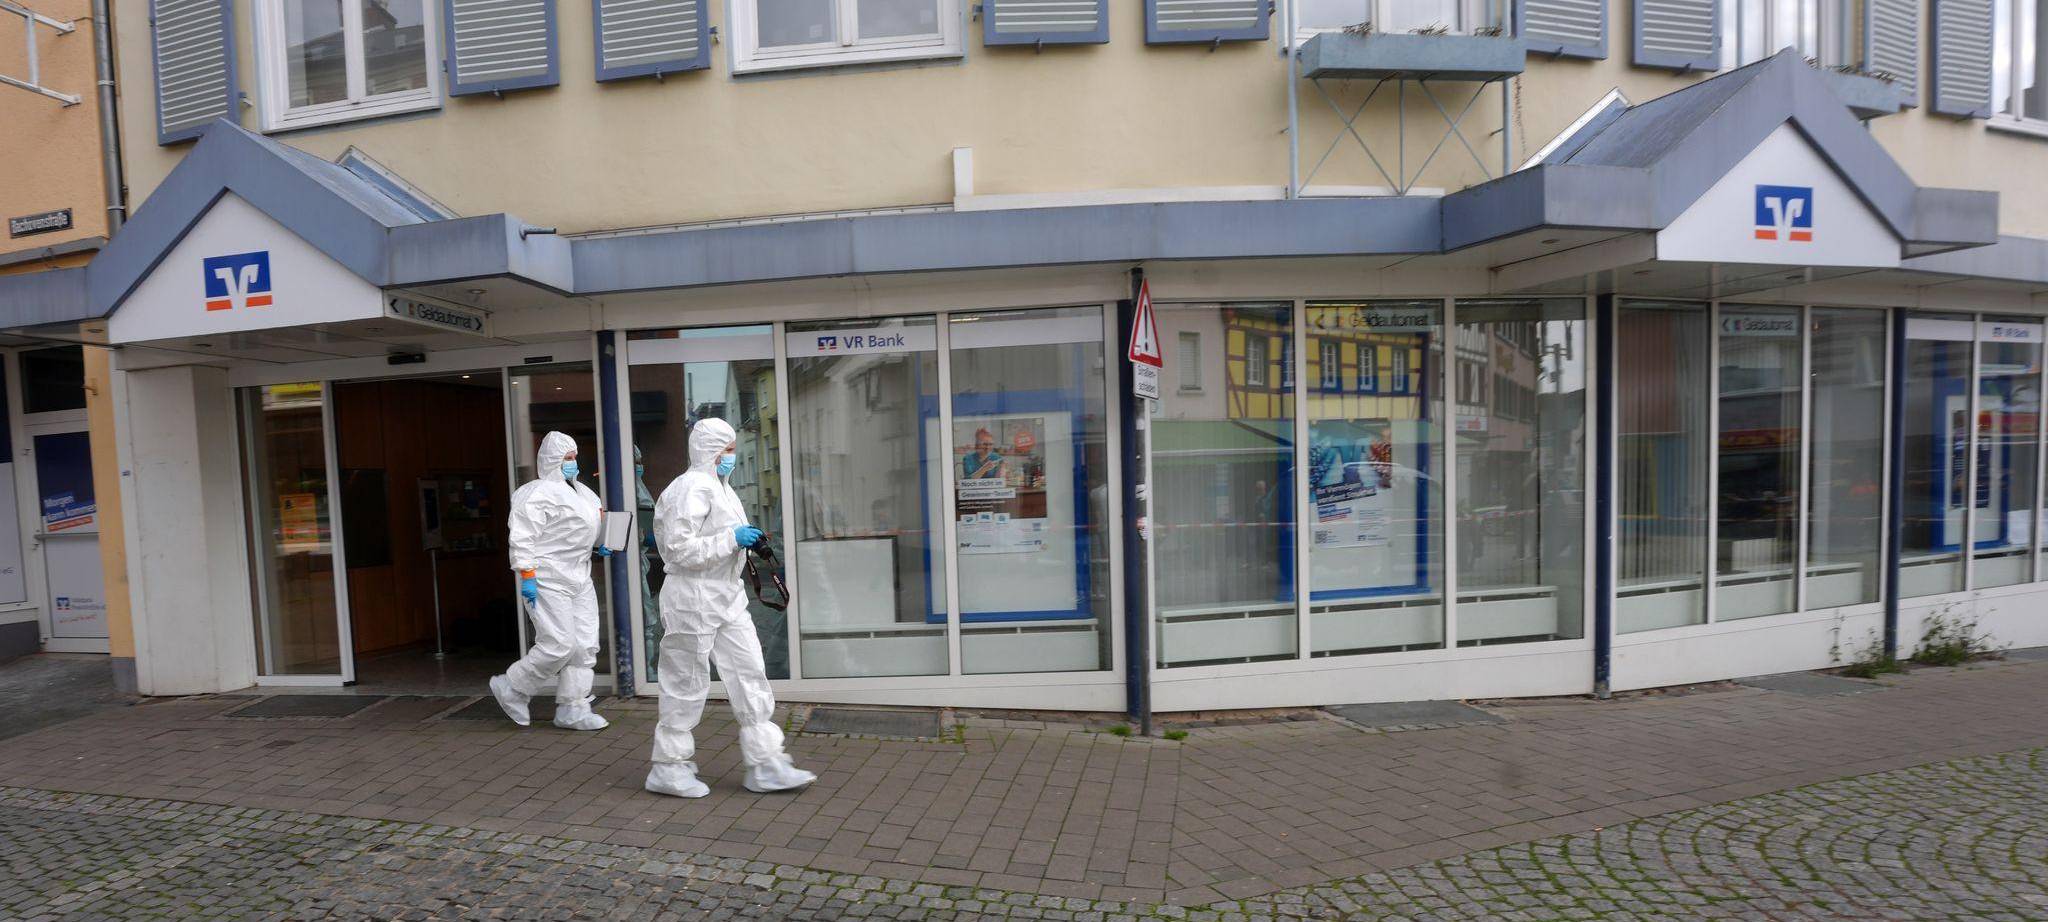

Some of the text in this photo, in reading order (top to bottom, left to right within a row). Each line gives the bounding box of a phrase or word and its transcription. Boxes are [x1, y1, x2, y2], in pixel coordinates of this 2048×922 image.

[417, 303, 473, 329] Geldautomat
[1349, 313, 1429, 328] Geldautomat
[843, 333, 905, 349] VR Bank
[44, 495, 74, 508] Morgen
